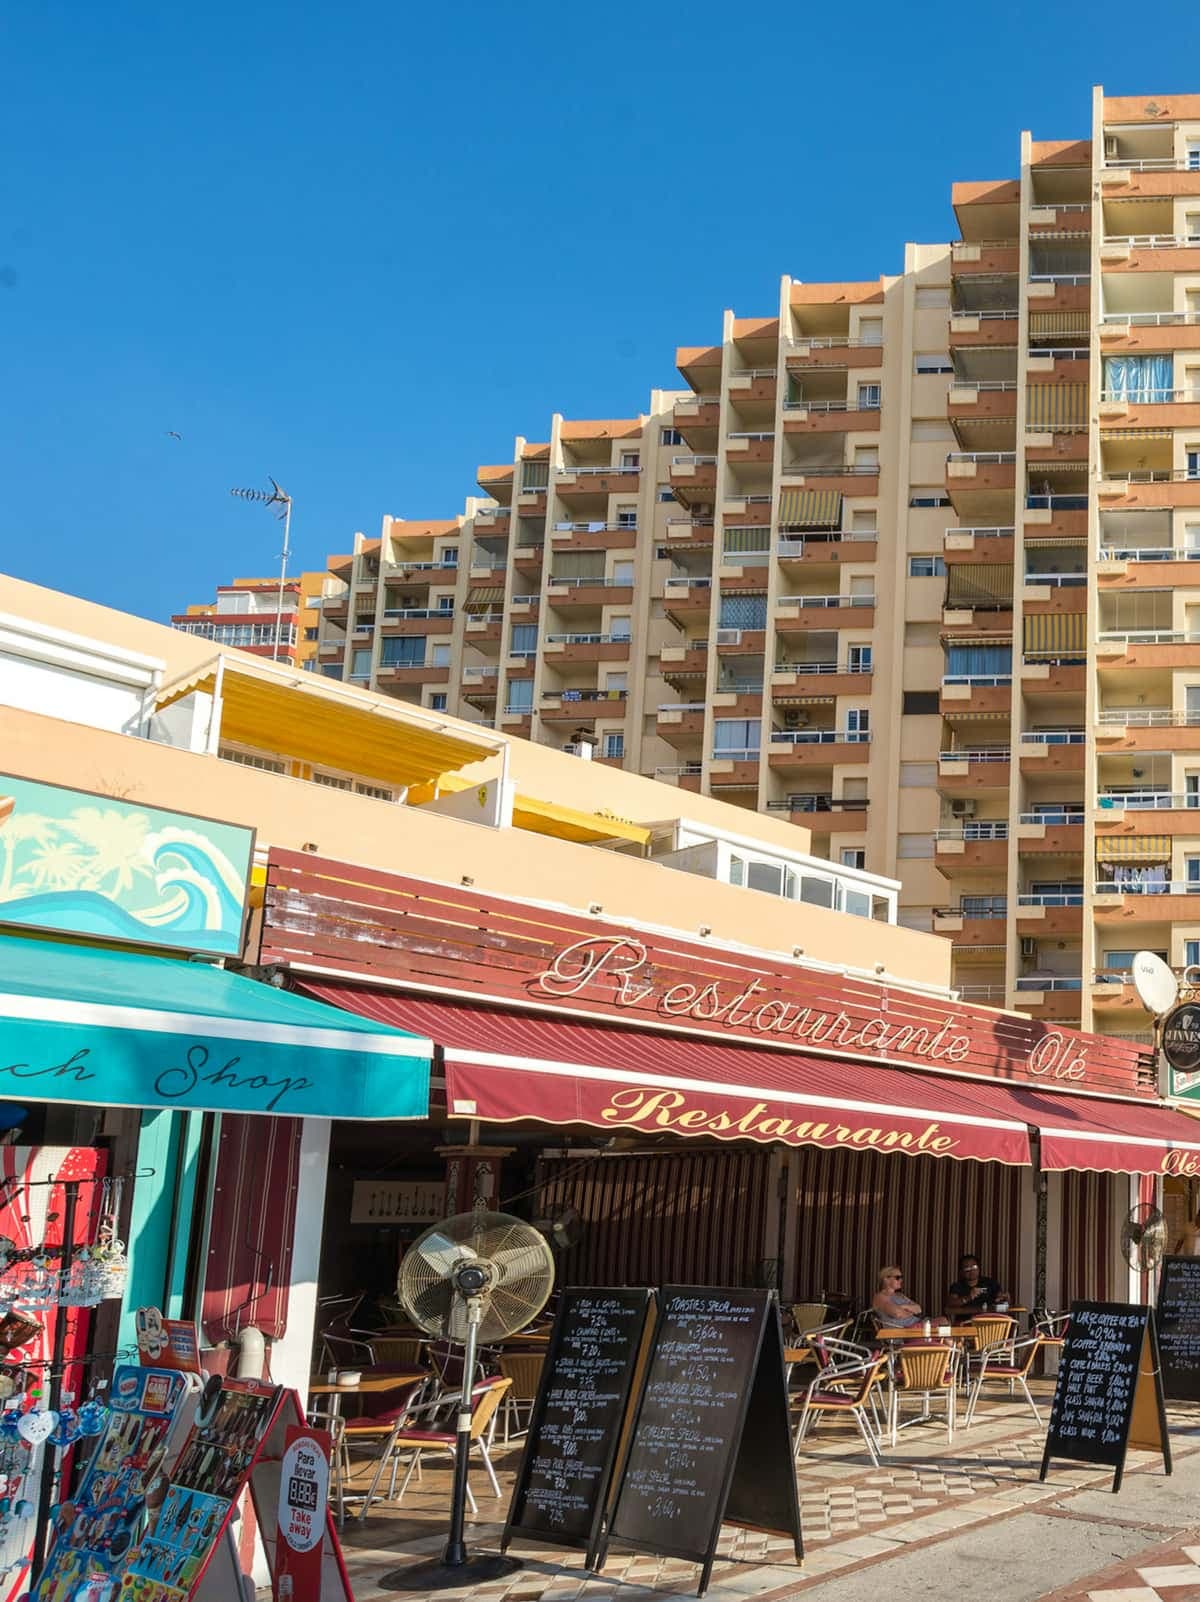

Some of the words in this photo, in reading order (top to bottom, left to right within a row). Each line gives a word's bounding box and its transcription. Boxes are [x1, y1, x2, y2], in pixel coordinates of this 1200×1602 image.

[540, 935, 970, 1062] Restaurante
[1030, 1031, 1088, 1080] Olé
[0, 1048, 96, 1081] ch
[154, 1045, 314, 1111] Shop
[602, 1087, 960, 1152] Restaurante
[1161, 1149, 1200, 1174] Olé
[671, 1296, 705, 1313] TOASTIES
[1097, 1314, 1119, 1326] COFFEE
[1128, 1315, 1139, 1328] TEA
[1071, 1338, 1097, 1350] COFFEE
[1086, 1374, 1104, 1384] BEER
[1064, 1394, 1082, 1409] GLASS
[1059, 1424, 1077, 1439] GLASS
[297, 1450, 315, 1466] Para
[294, 1463, 316, 1480] llevar
[291, 1508, 312, 1525] Take
[289, 1523, 312, 1540] away
